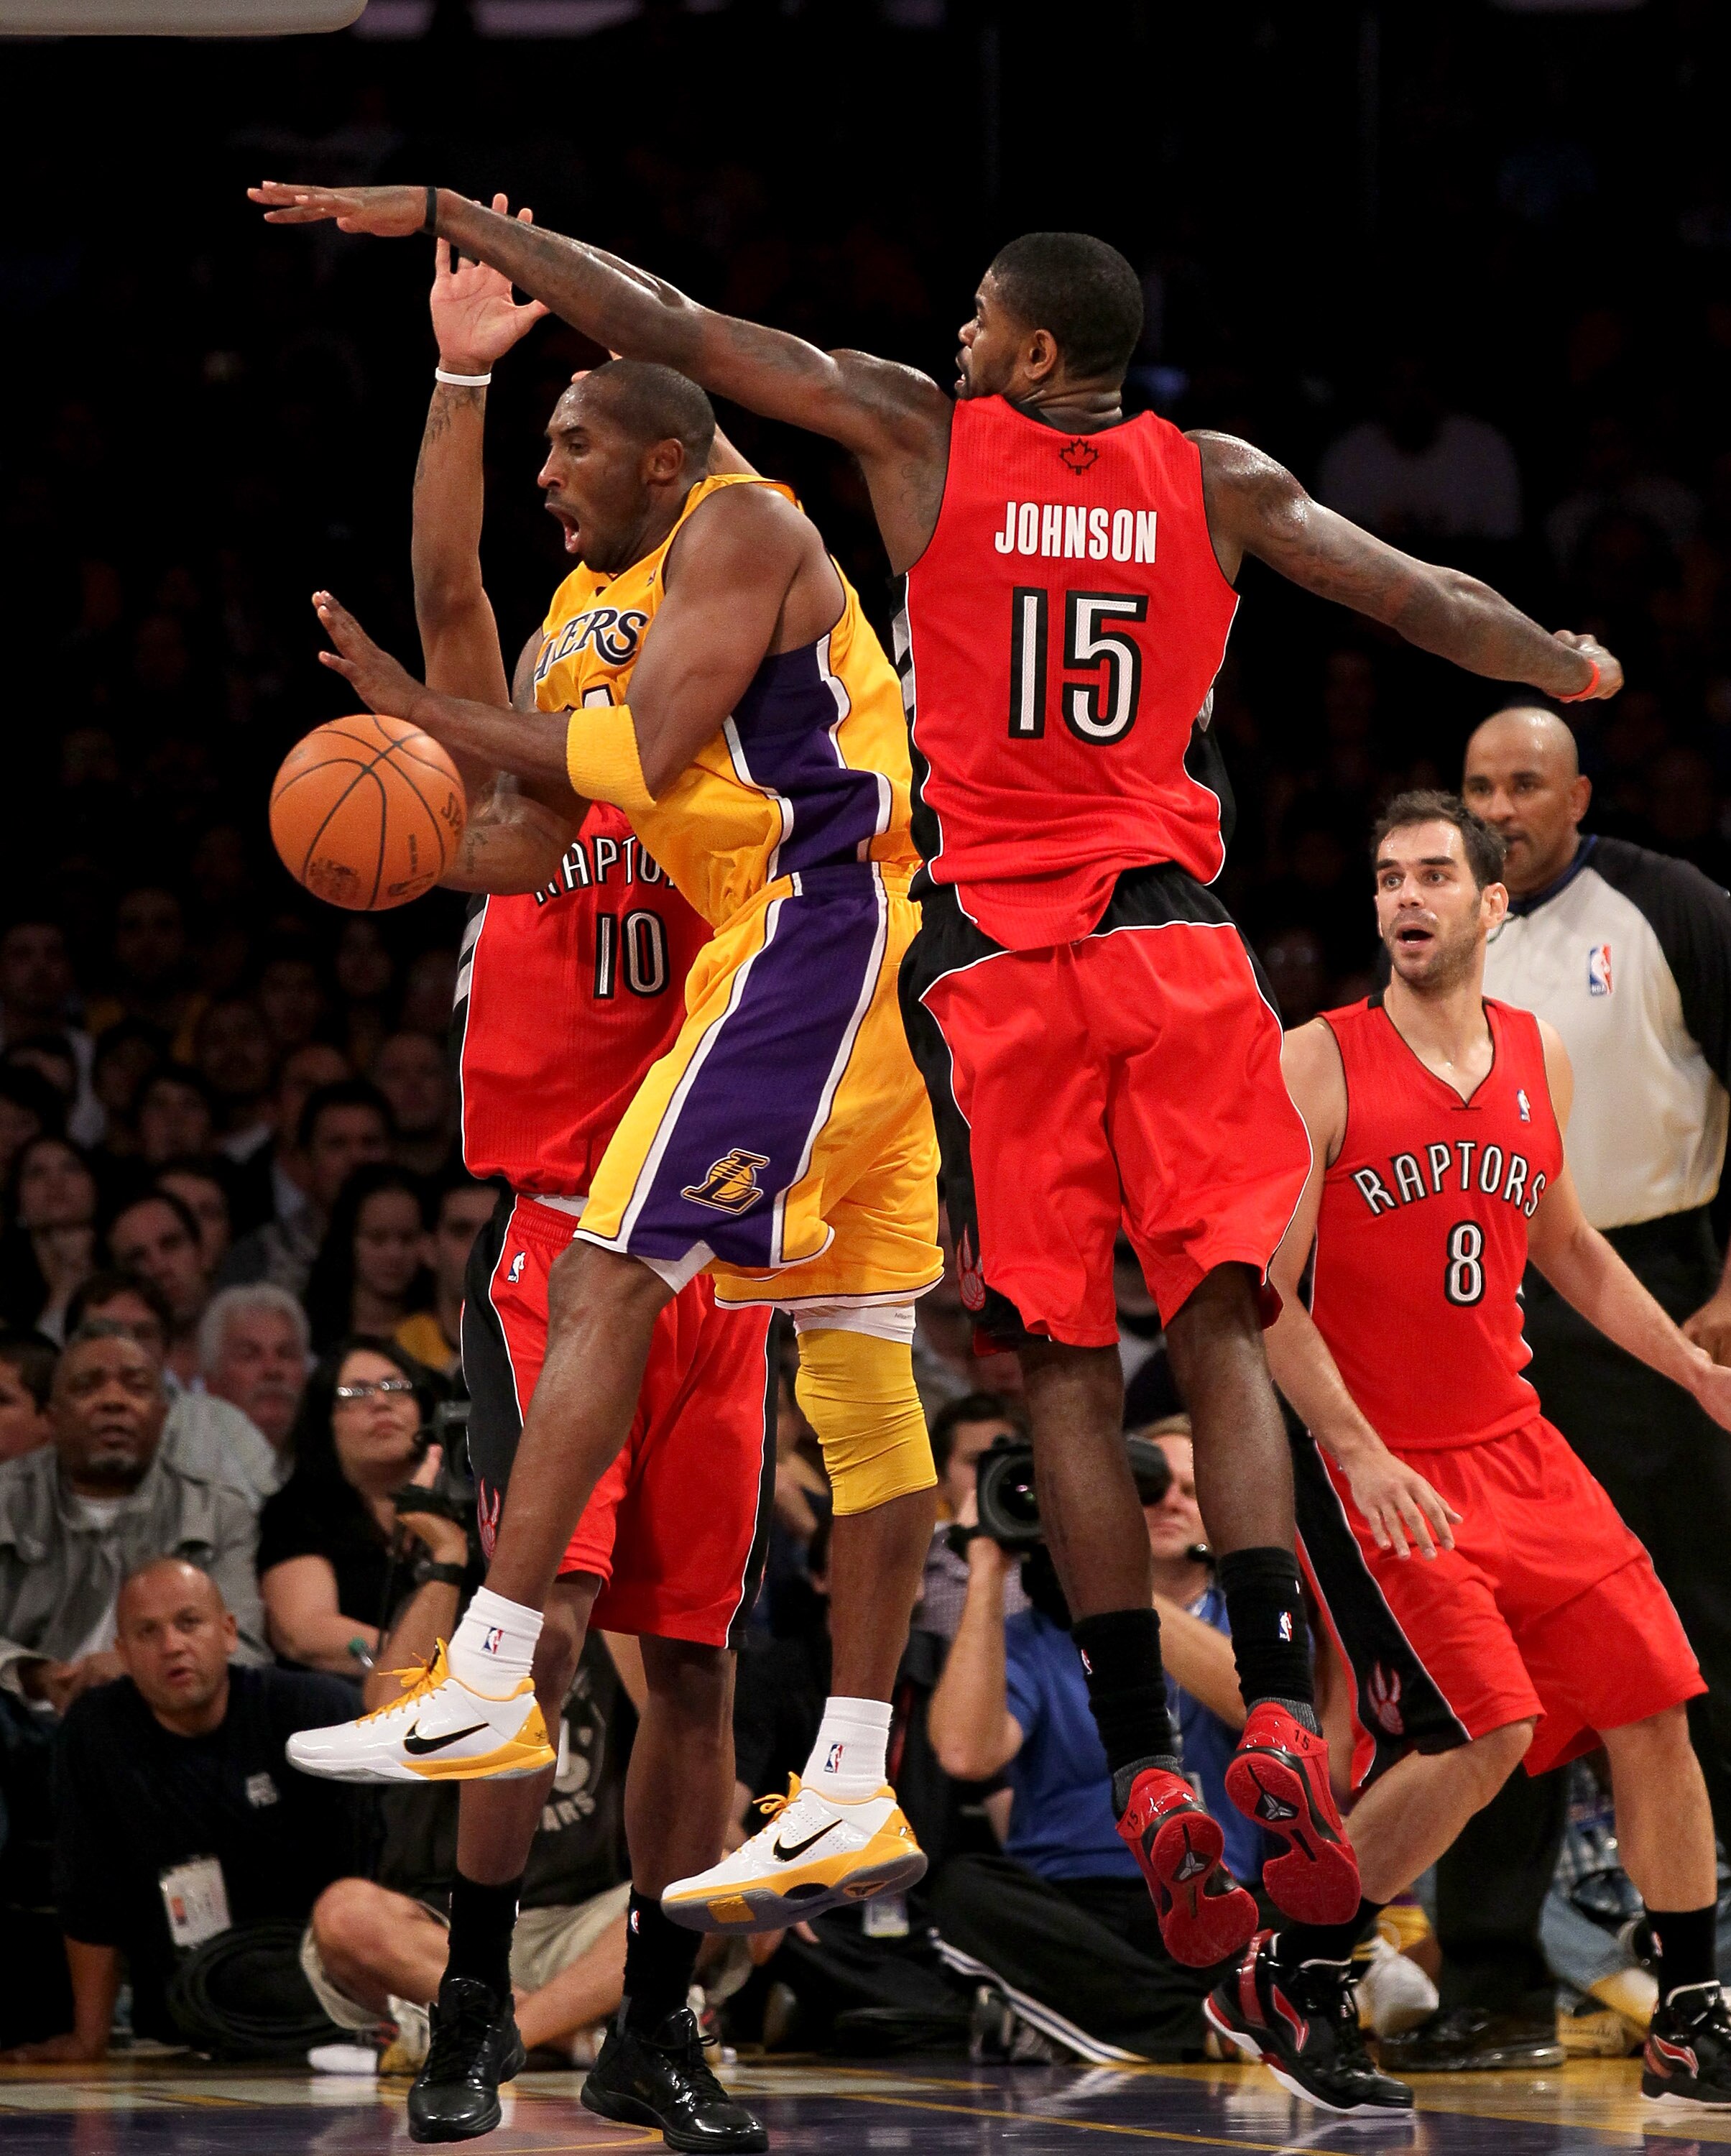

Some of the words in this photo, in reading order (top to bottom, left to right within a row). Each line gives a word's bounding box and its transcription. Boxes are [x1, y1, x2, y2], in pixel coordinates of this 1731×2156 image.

[994, 501, 1158, 564] JOHNSON
[1008, 586, 1150, 747] 15
[534, 834, 675, 908] APTO
[594, 908, 671, 1000] 10
[1349, 1140, 1548, 1220] RAPTORS
[1444, 1219, 1487, 1307] 8
[1294, 1728, 1311, 1752] 15
